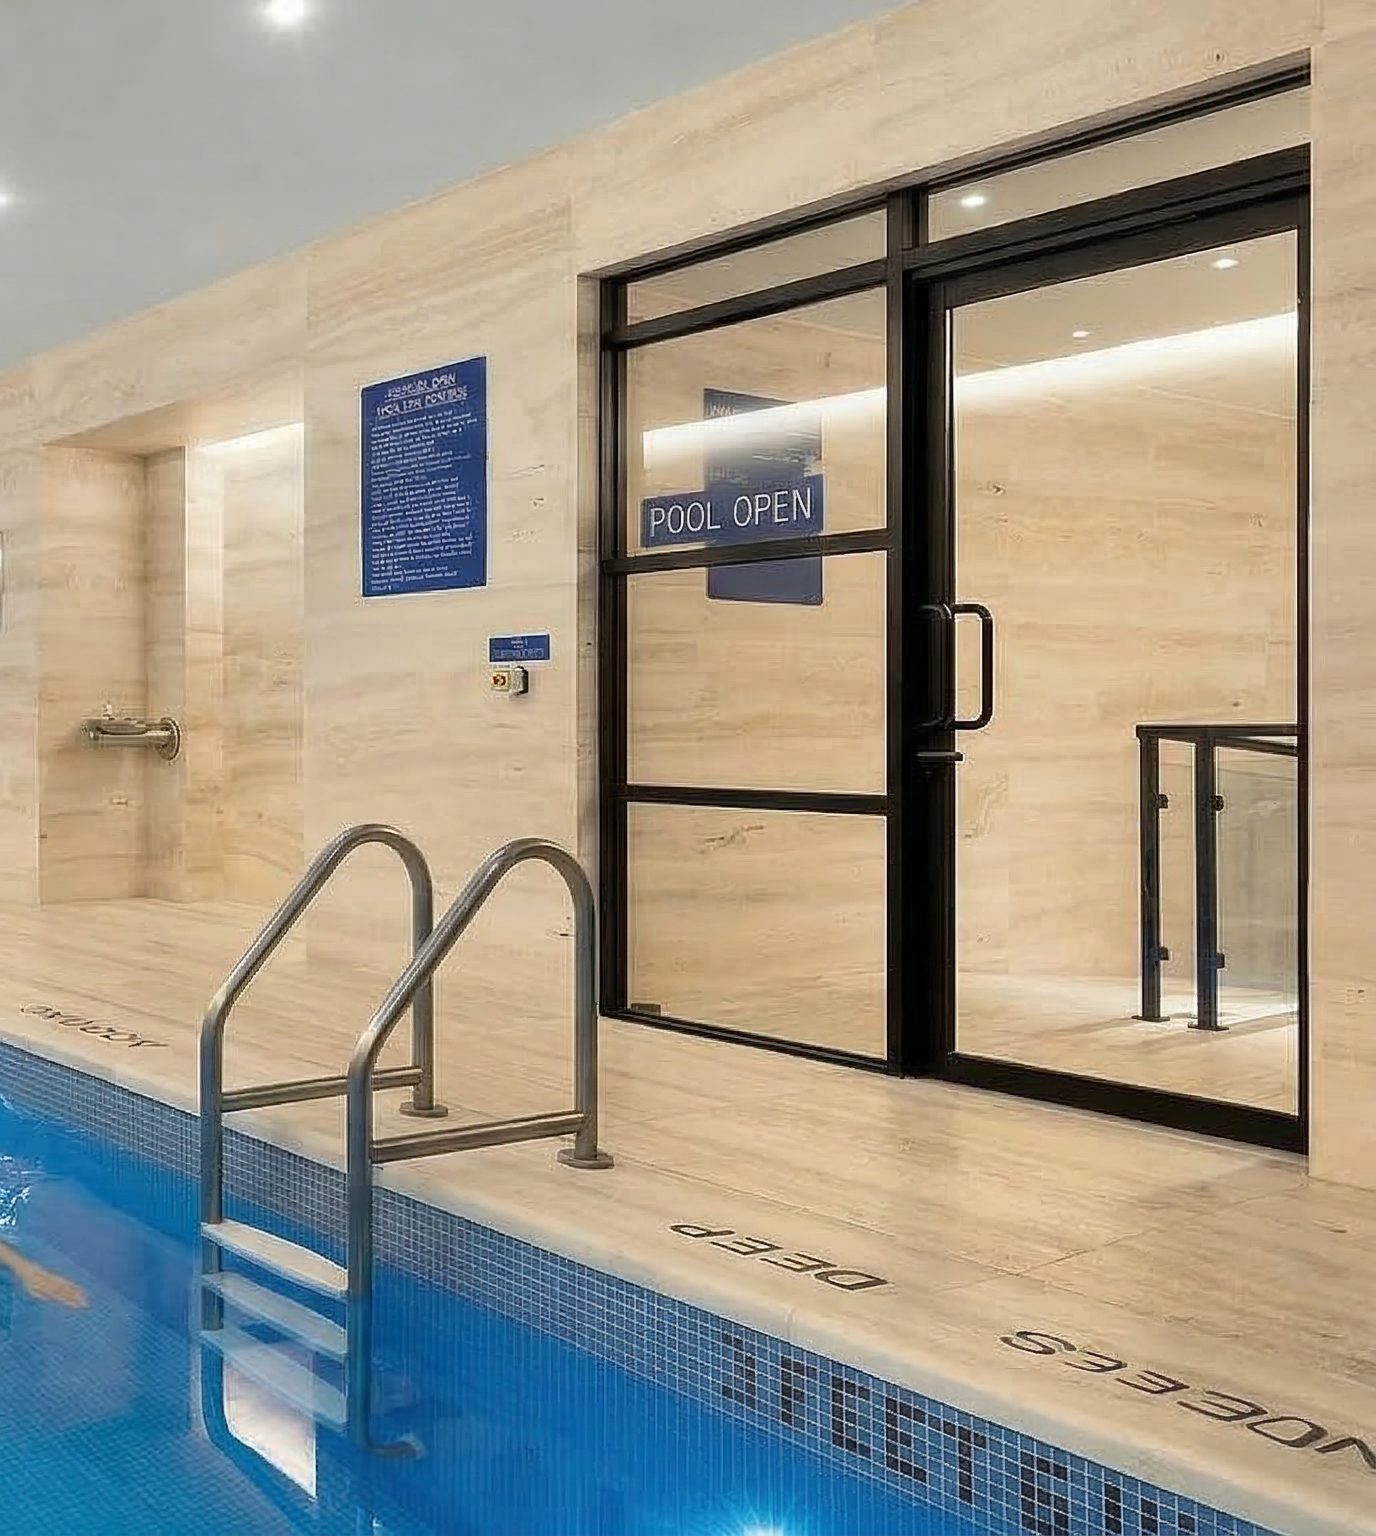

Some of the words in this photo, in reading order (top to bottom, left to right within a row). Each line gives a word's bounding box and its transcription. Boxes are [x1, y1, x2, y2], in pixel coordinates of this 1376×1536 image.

[650, 502, 721, 537] POOL
[733, 487, 811, 527] OPEN
[670, 1225, 887, 1290] DEEP
